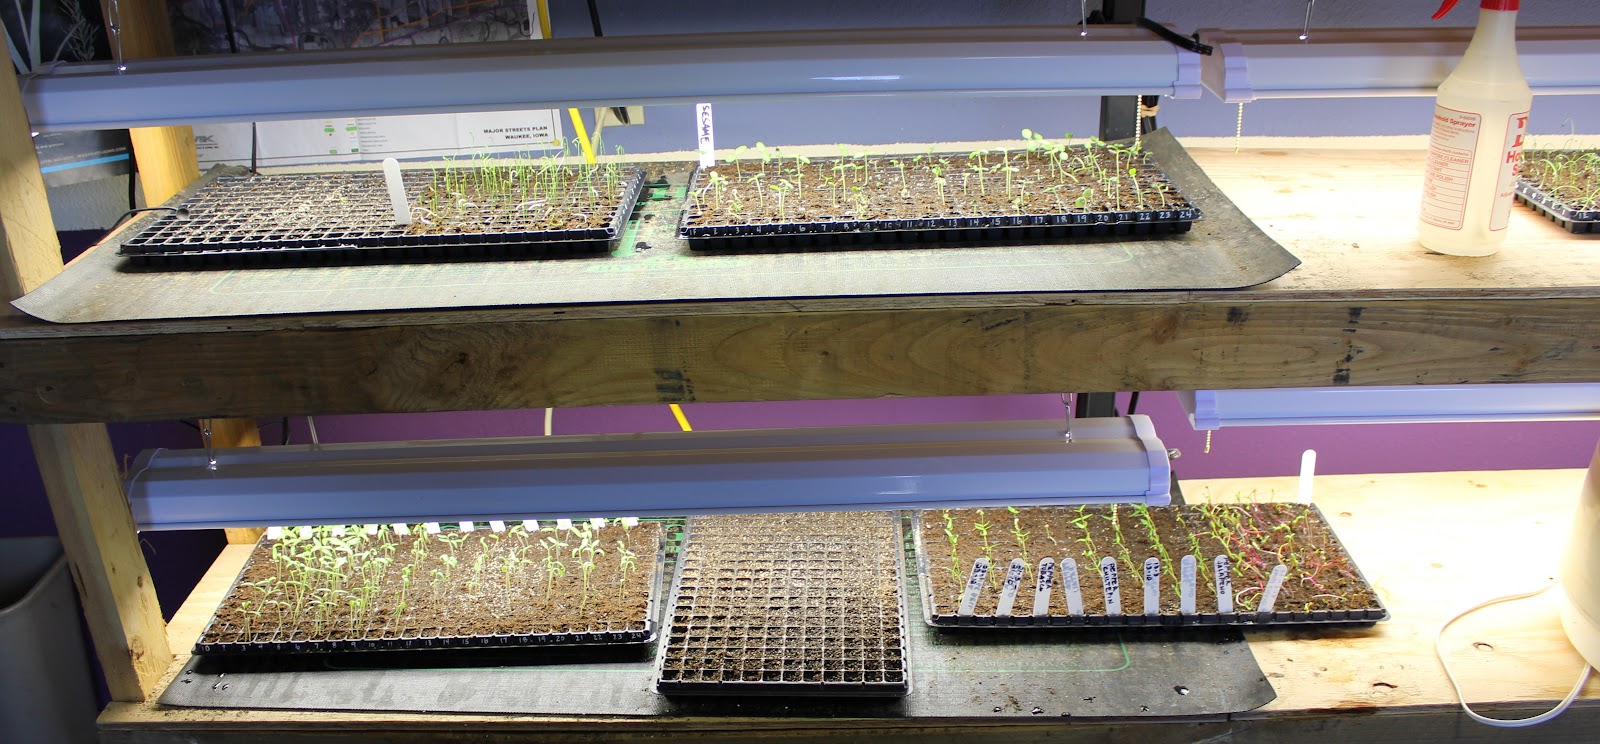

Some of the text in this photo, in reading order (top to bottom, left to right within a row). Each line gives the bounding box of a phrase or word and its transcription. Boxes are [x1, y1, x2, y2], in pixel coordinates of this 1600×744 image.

[701, 105, 711, 144] SESAME
[1449, 118, 1476, 128] Sprayer
[1139, 212, 1151, 220] 22
[1160, 211, 1171, 219] 23
[1179, 209, 1192, 218] 24
[969, 218, 980, 226] 14
[990, 217, 1001, 225] 15
[1012, 216, 1023, 225] 16
[1034, 216, 1044, 224] 17
[1056, 215, 1068, 223] 18
[1077, 214, 1088, 223] 19
[948, 219, 958, 227] 13
[713, 227, 719, 235] 2
[735, 226, 741, 234] 3
[756, 225, 762, 233] 4
[777, 225, 783, 233] 5
[1109, 562, 1118, 592] PEPPER
[1217, 561, 1225, 595] JALAPENO
